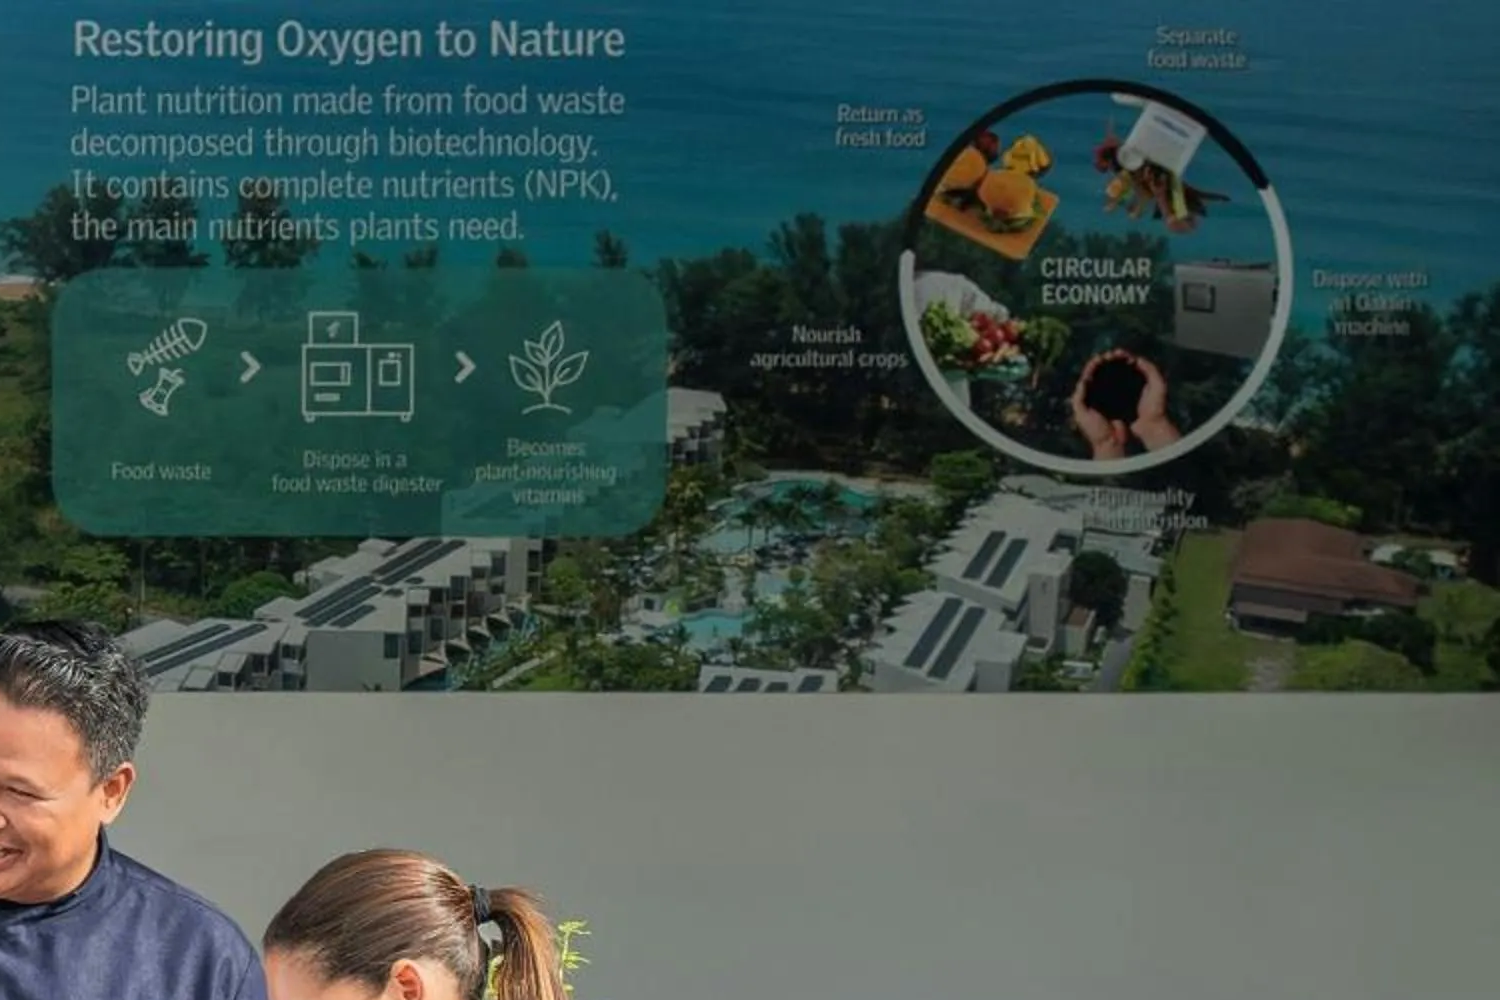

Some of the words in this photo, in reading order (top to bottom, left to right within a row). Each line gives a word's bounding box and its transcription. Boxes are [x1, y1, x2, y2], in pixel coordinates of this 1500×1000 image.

[73, 19, 264, 65] Restoring
[277, 19, 423, 65] Oxygen
[436, 22, 478, 58] to
[490, 19, 626, 58] Nature
[1156, 25, 1238, 46] Separate
[1147, 49, 1187, 68] food
[71, 85, 147, 116] Plant
[156, 85, 283, 116] nutrition
[292, 85, 373, 116] made
[382, 85, 453, 116] from
[462, 85, 527, 116] food
[537, 89, 625, 116] waste
[837, 104, 898, 123] Return
[902, 108, 924, 123] as
[70, 128, 253, 163] decomposed
[264, 128, 379, 163] through
[389, 128, 599, 163] biotechnology.
[835, 128, 881, 147] fresh
[885, 128, 926, 147] food
[72, 171, 97, 200] It
[106, 171, 230, 200] contains
[238, 171, 374, 207] complete
[382, 171, 515, 200] nutrients
[524, 169, 619, 206] (NPK),
[70, 213, 118, 242] the
[127, 213, 198, 242] main
[209, 213, 340, 242] nutrients
[349, 213, 441, 248] plants
[449, 213, 526, 242] need.
[1040, 257, 1152, 279] CIRCULAR
[1041, 284, 1151, 305] ECONOMY
[791, 325, 862, 344] Nourish
[750, 349, 853, 369] agricultural
[857, 352, 908, 370] crops
[506, 438, 586, 458] Becomes
[303, 450, 370, 471] Dispose
[375, 450, 391, 468] in
[395, 452, 407, 468] a
[111, 462, 154, 481] Food
[159, 464, 211, 481] waste
[271, 474, 311, 493] food
[316, 475, 368, 493] waste
[372, 474, 443, 497] digester
[512, 488, 586, 504] vitamins
